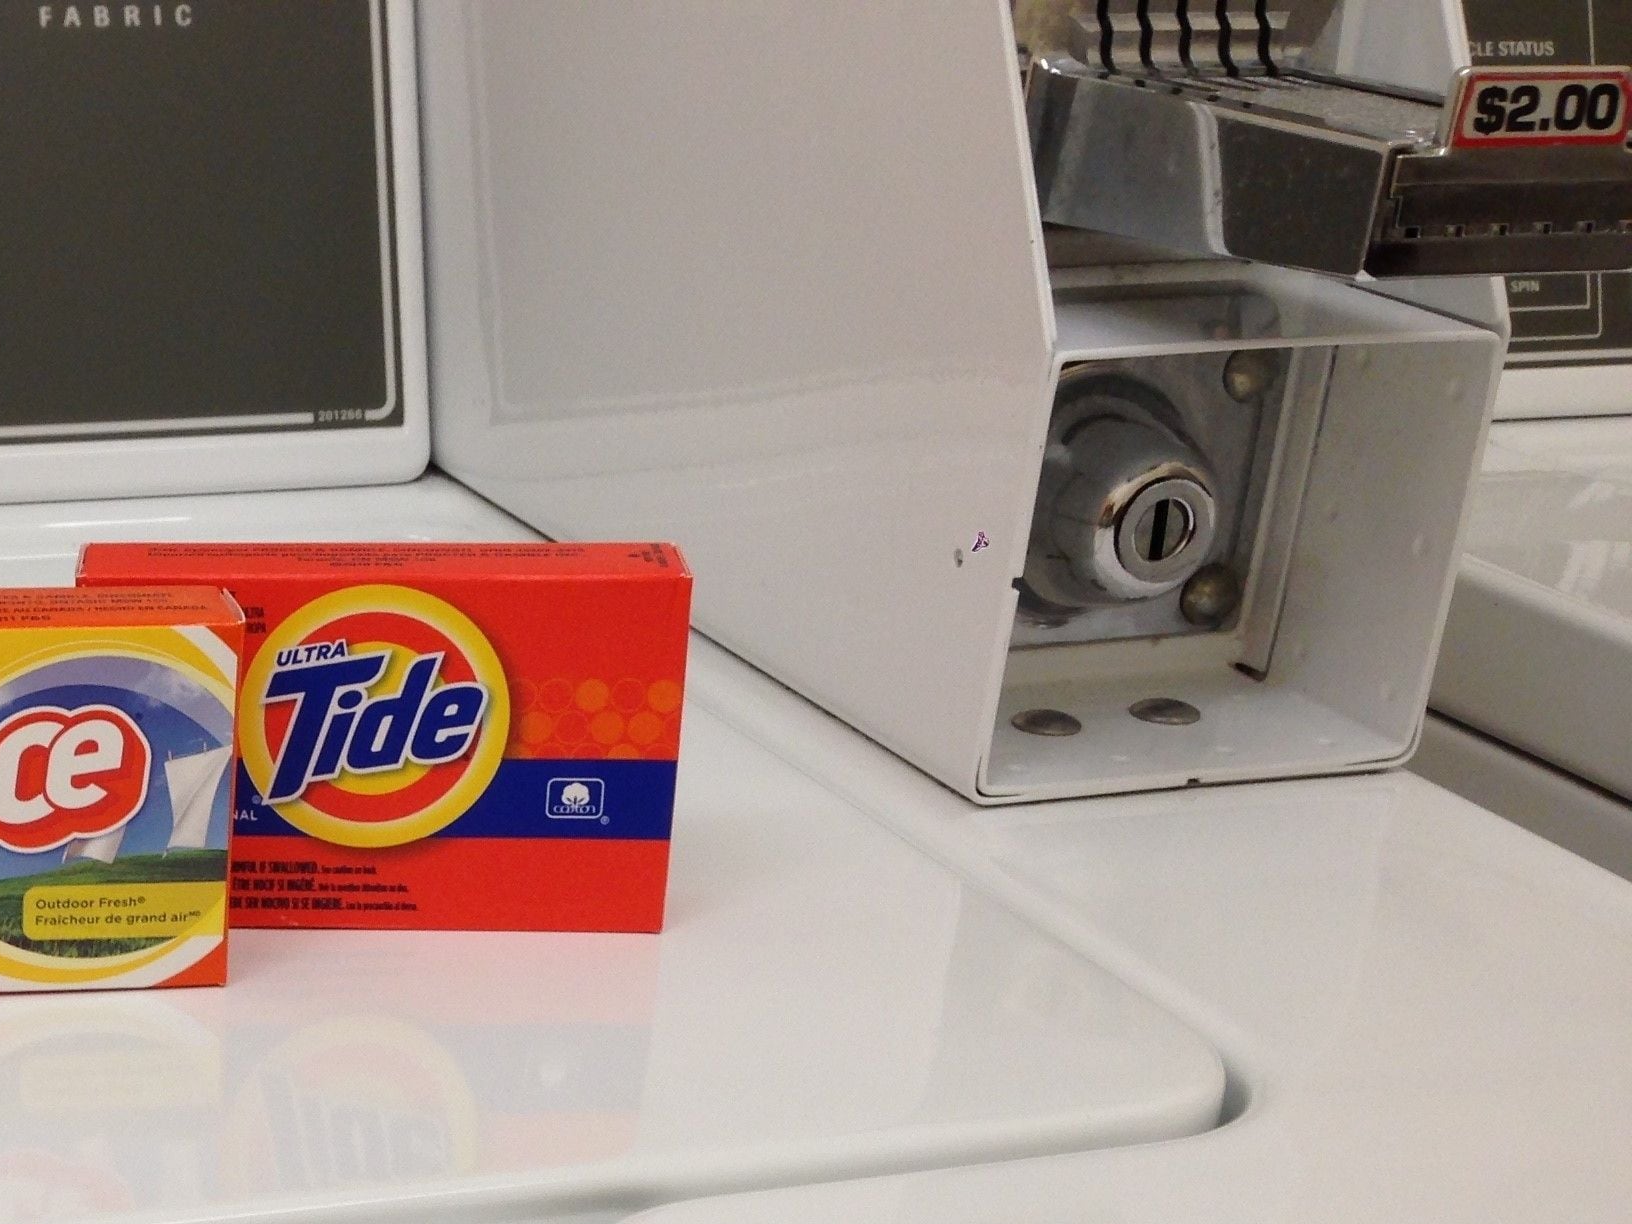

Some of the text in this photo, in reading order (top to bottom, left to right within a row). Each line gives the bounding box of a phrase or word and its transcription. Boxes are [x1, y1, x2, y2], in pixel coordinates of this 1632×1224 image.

[39, 4, 193, 29] FABRIC
[1498, 40, 1555, 57] STATUS
[1473, 83, 1620, 135] $2.00
[1510, 280, 1540, 294] SPIN
[276, 640, 346, 667] ULTRA
[260, 652, 487, 803] Tide
[35, 897, 94, 910] Outdoor
[105, 913, 122, 924] de
[126, 911, 166, 925] grand
